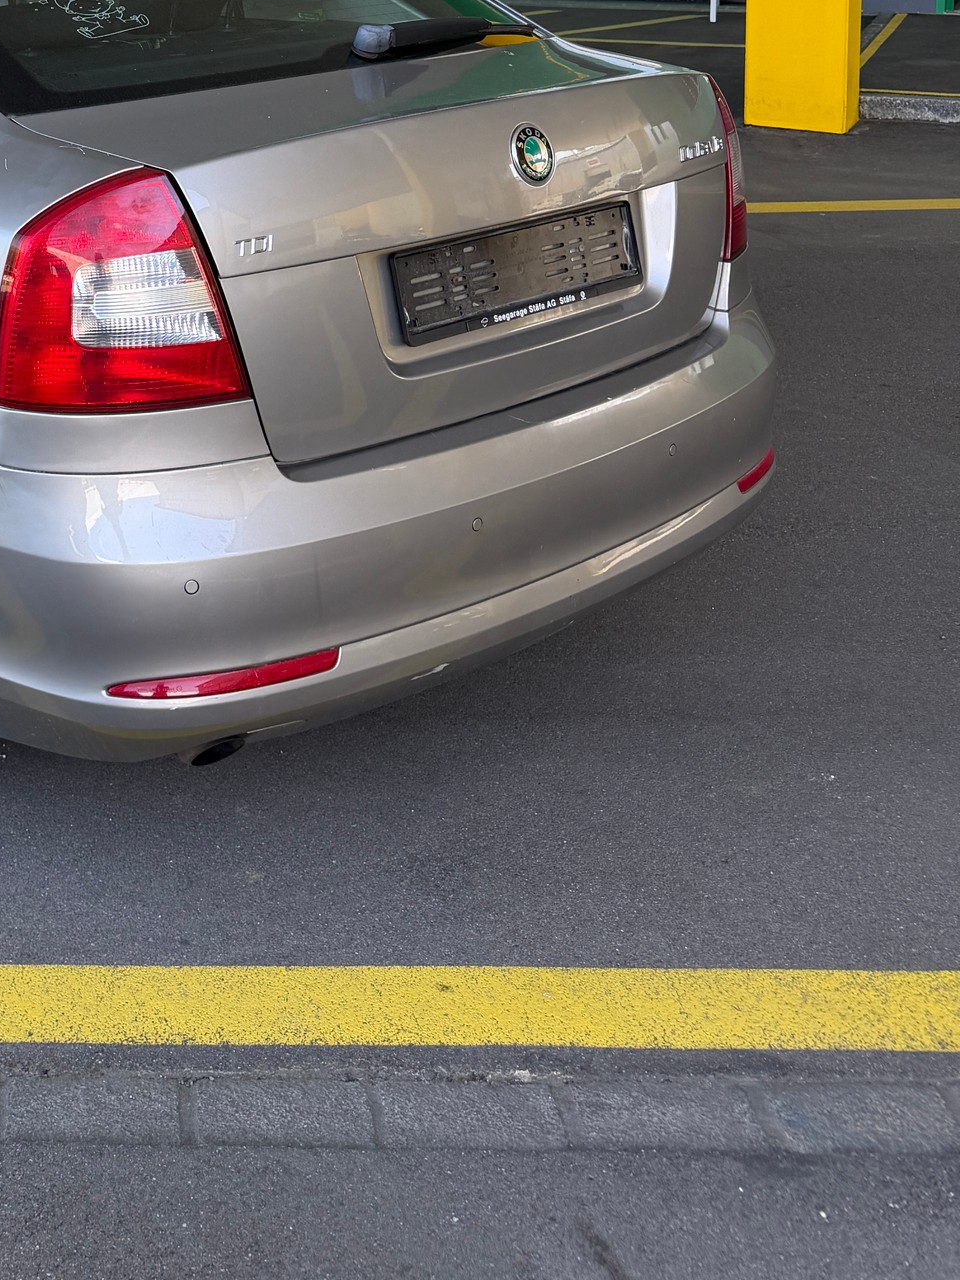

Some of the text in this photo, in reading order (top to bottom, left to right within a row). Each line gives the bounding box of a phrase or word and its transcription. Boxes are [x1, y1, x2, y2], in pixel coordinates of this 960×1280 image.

[232, 234, 273, 257] TDI
[493, 307, 528, 323] Seegarage
[528, 302, 546, 314] Stäfa
[546, 299, 557, 308] AG
